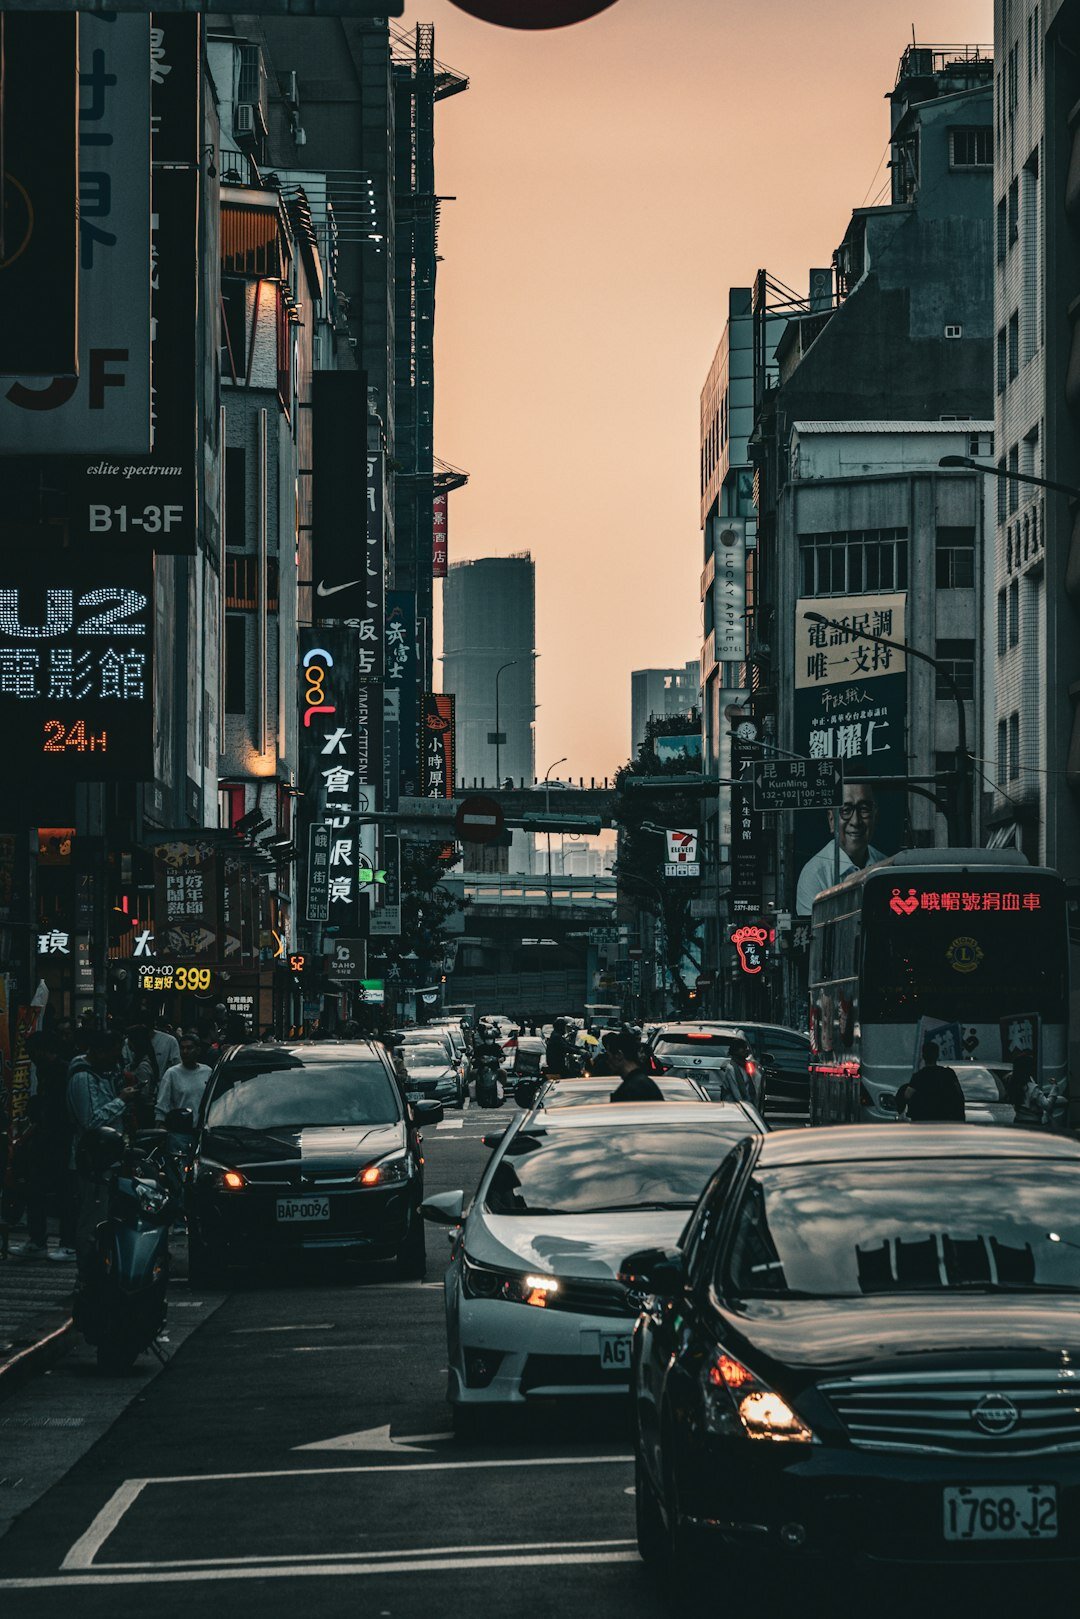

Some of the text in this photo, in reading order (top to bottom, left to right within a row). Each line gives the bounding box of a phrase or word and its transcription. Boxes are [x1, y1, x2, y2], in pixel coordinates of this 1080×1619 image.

[86, 461, 183, 479] eslite spectrum
[88, 504, 184, 533] B1-3F
[725, 552, 734, 642] LUCKY APPLE
[0, 587, 147, 637] U2
[807, 608, 893, 648] 電話民調
[0, 648, 146, 700] 電影館
[807, 643, 893, 681] 唯一支持
[821, 686, 874, 713] 市政職人
[43, 720, 107, 752] 24H
[808, 720, 891, 759] 劉耀仁
[763, 761, 834, 779] 昆明街
[768, 779, 828, 789] KunMing St.
[774, 799, 784, 807] 77
[312, 834, 328, 884] 峨眉街
[290, 956, 305, 971] 52
[174, 966, 211, 991] 399
[277, 1203, 330, 1220] BAP-0096
